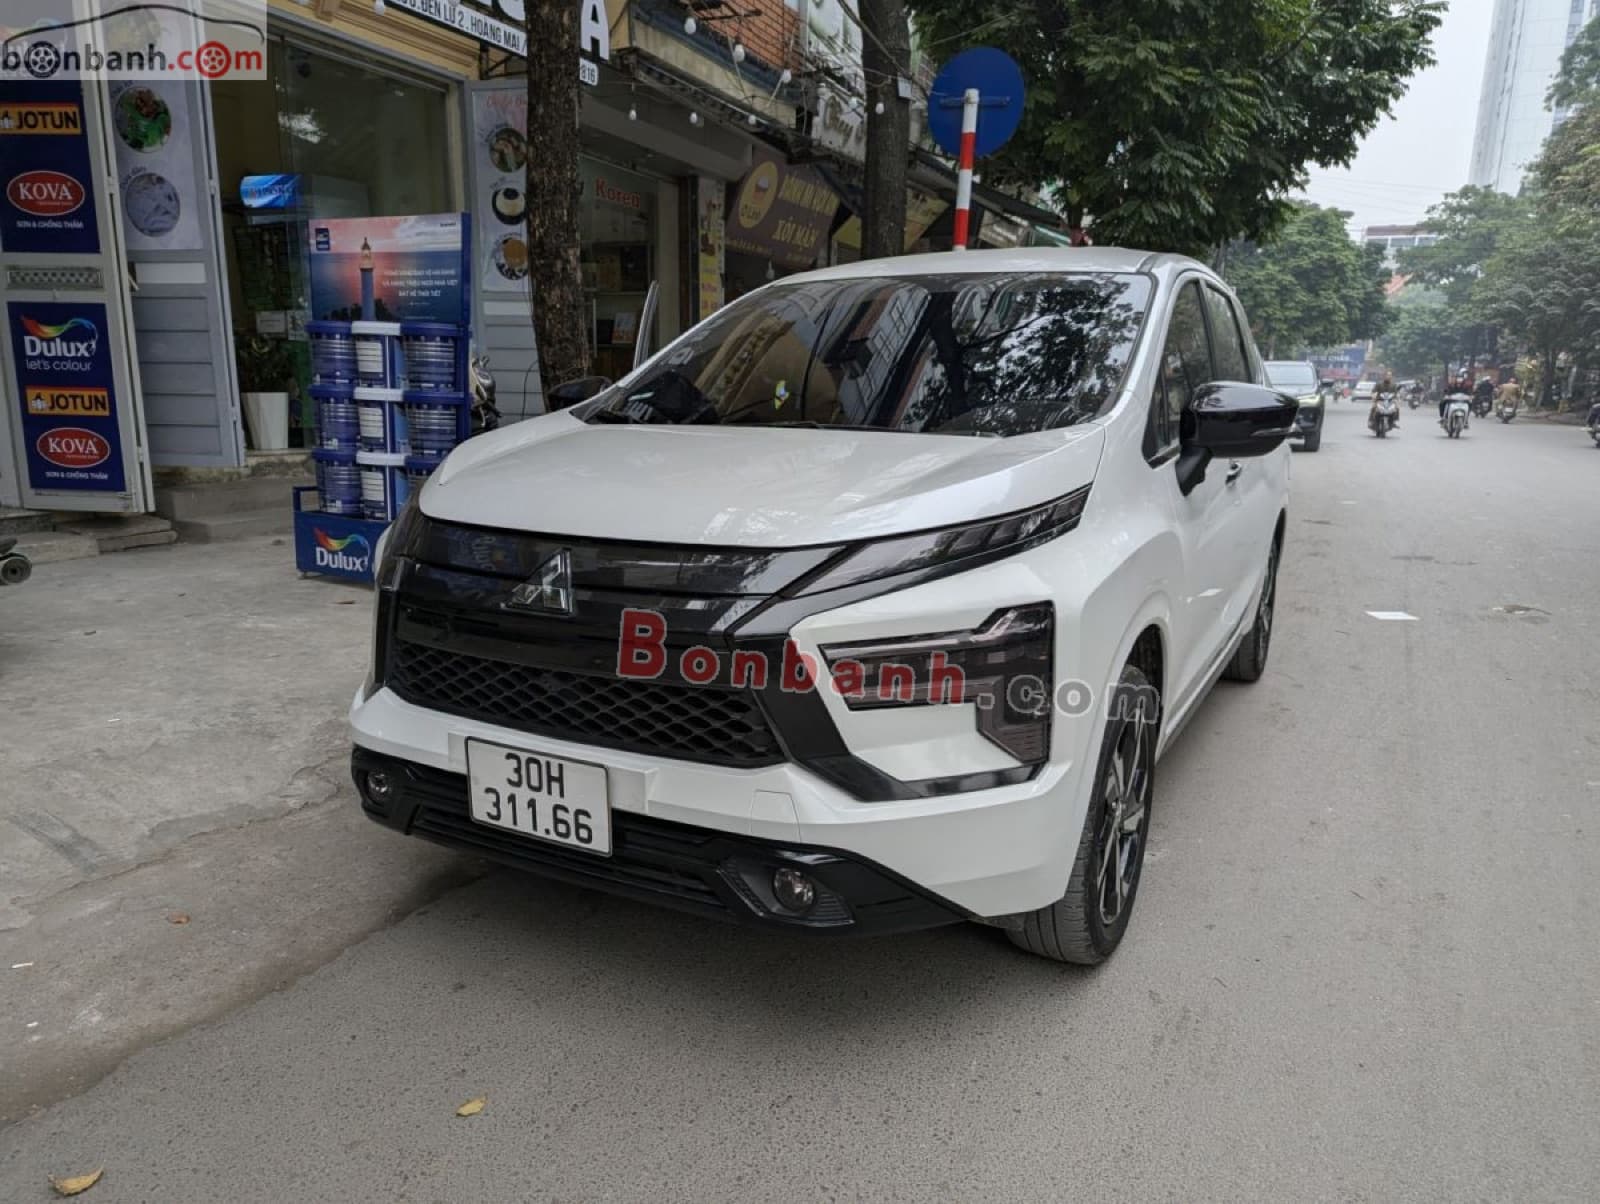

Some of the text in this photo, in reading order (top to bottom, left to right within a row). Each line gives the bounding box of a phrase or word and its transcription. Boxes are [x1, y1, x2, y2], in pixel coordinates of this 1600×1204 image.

[503, 30, 521, 51] MAI
[16, 111, 79, 130] JOTUN
[19, 182, 73, 200] KOVA
[24, 335, 90, 357] Dulux
[26, 358, 92, 372] let's colour
[48, 394, 107, 412] JOTUN
[48, 437, 98, 454] KOVA
[315, 547, 364, 572] Dulux
[505, 752, 565, 799] 30H
[484, 787, 593, 844] 311.66
